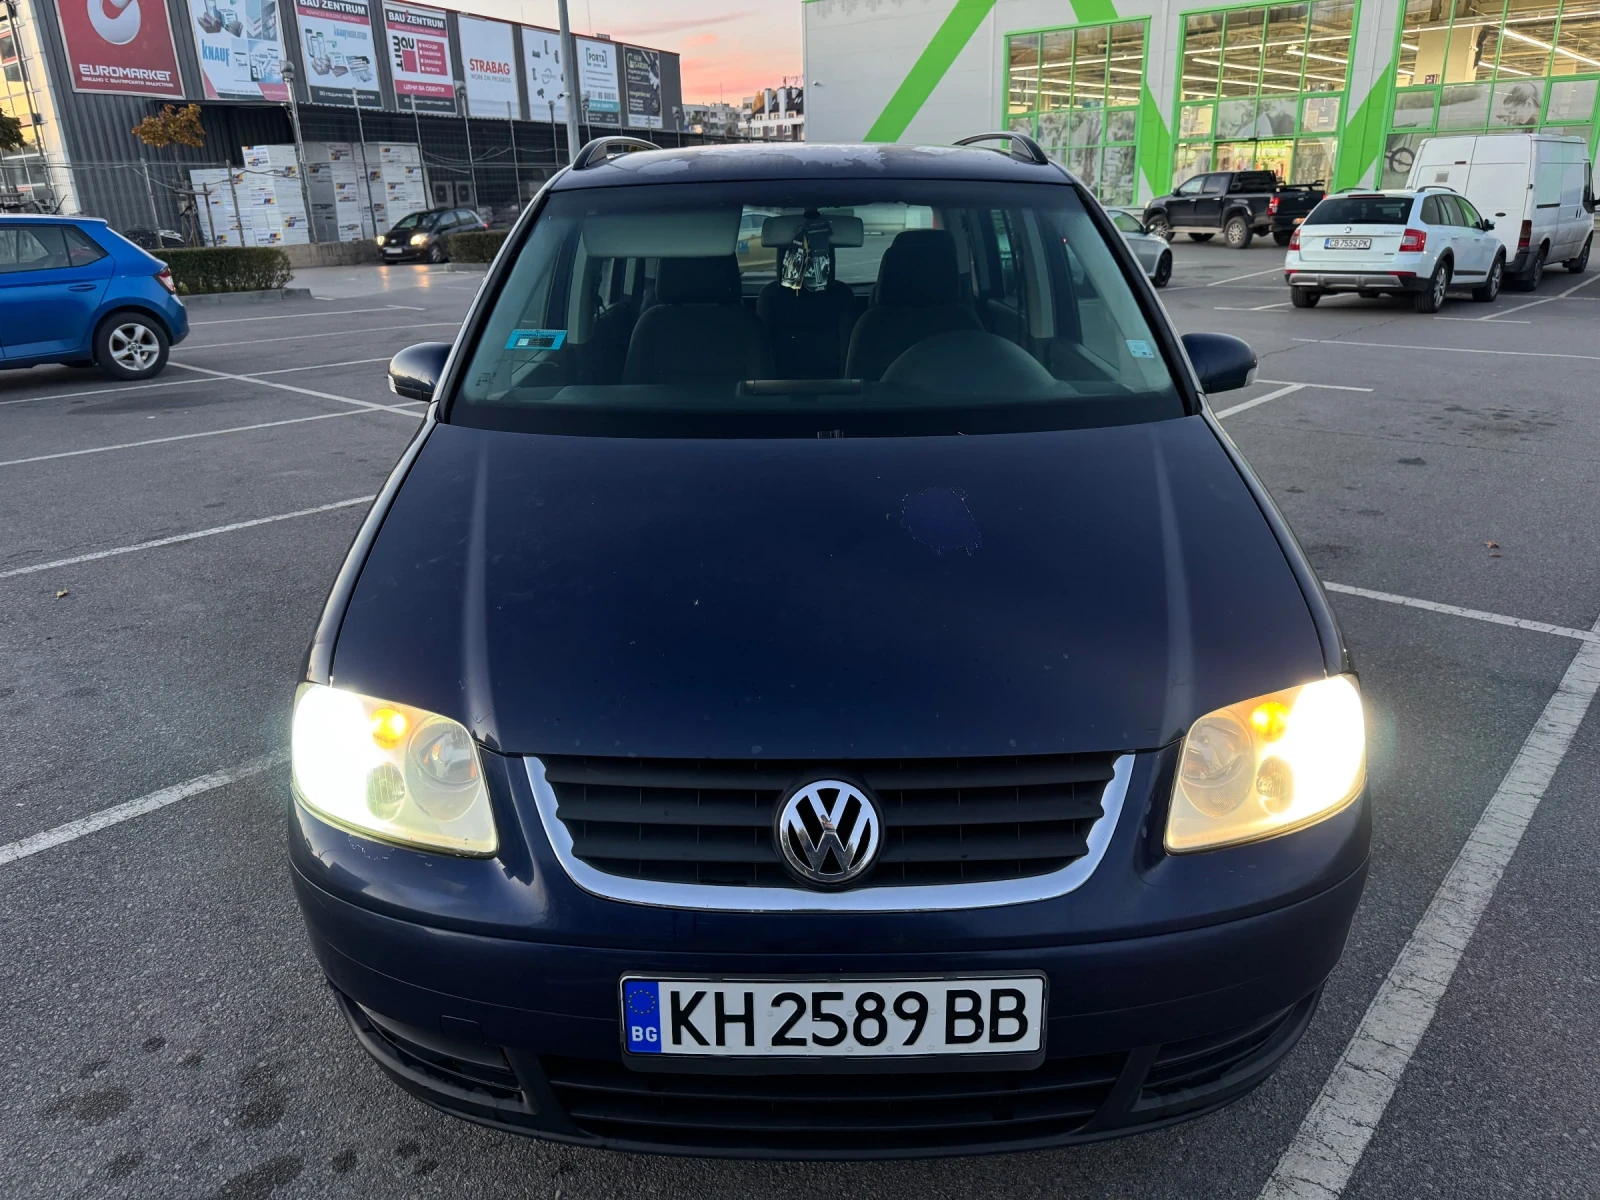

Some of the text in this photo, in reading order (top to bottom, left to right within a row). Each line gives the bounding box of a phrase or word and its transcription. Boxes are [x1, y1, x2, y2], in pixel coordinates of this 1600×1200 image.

[321, 0, 367, 15] ZENTRUM
[388, 11, 444, 28] BAU ZENTRUM
[588, 52, 606, 63] PORTA
[79, 63, 172, 81] EUROMARKET
[469, 58, 511, 75] STRABAG
[1329, 239, 1369, 248] CB 7552 PK
[670, 988, 1029, 1047] KH 2589 BB
[631, 1026, 658, 1043] BG
